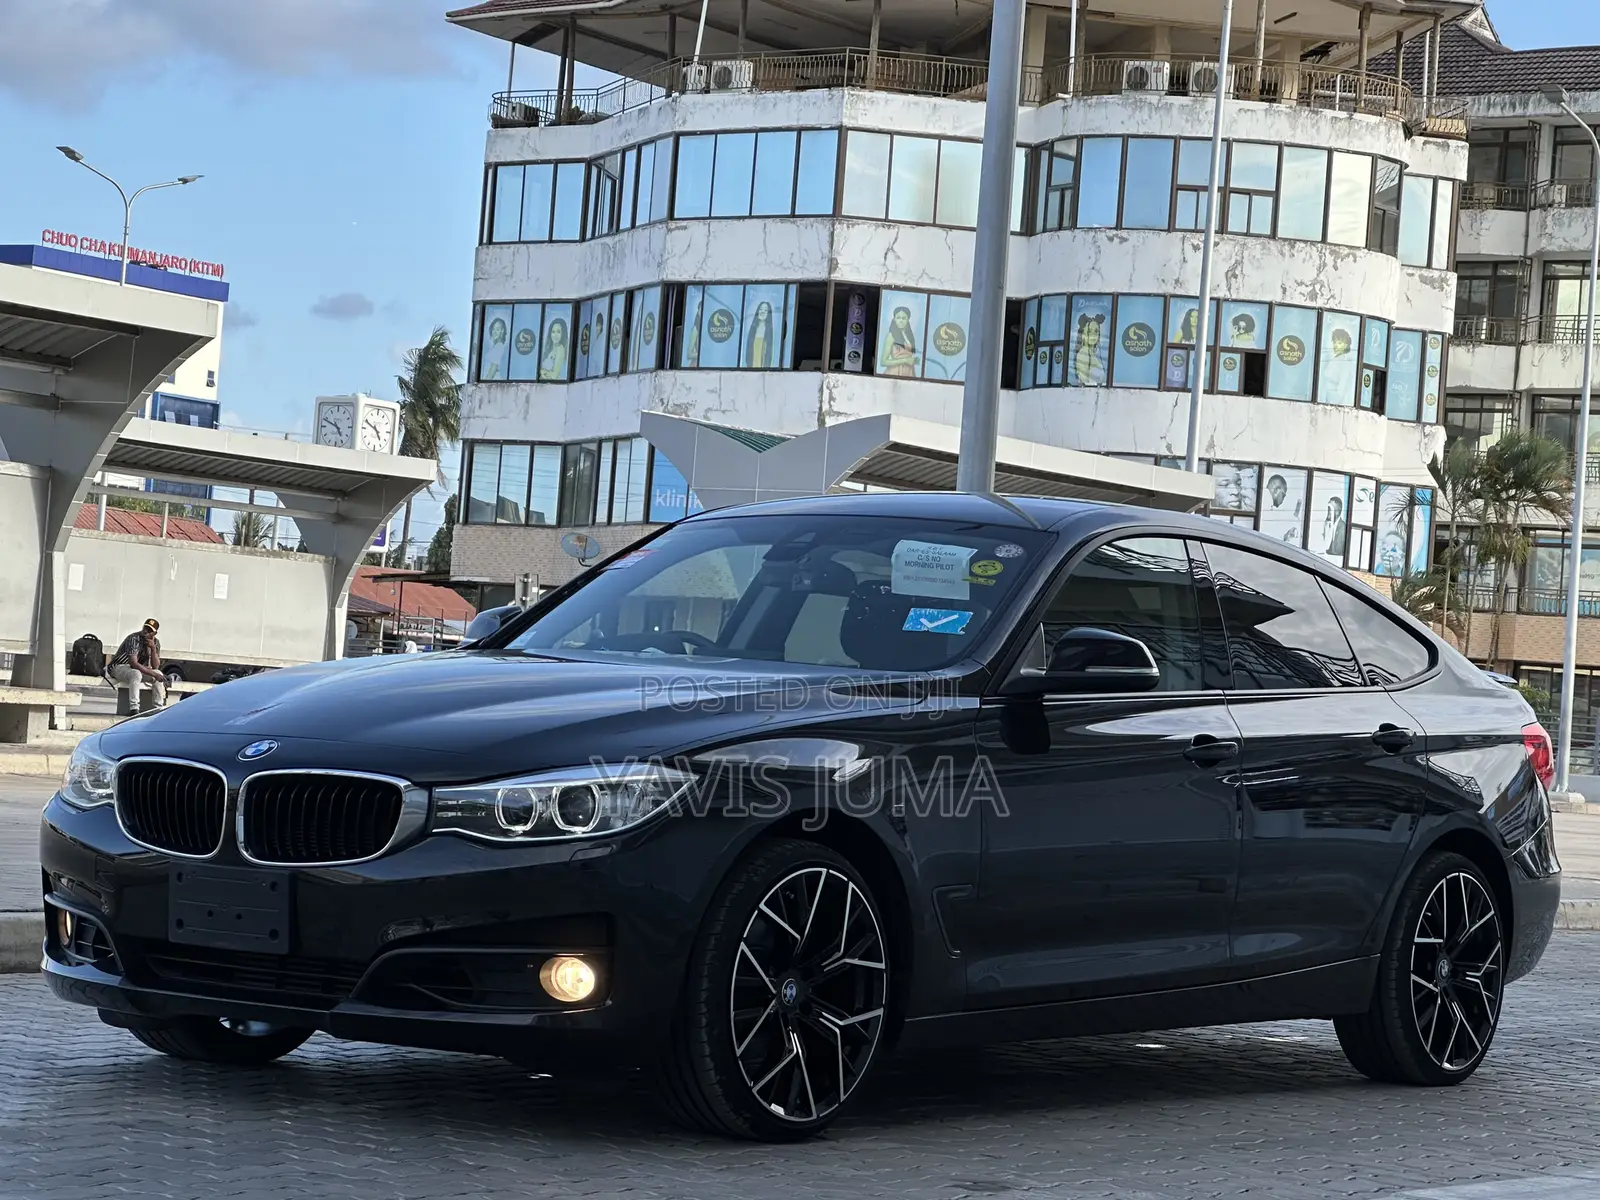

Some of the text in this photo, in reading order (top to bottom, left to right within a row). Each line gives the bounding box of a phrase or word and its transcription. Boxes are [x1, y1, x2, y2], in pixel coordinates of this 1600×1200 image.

[42, 229, 79, 248] CHUO
[80, 237, 107, 255] CHA
[189, 258, 225, 279] (KITM)
[1125, 339, 1151, 347] asnath
[904, 560, 955, 571] MORNING PILOT
